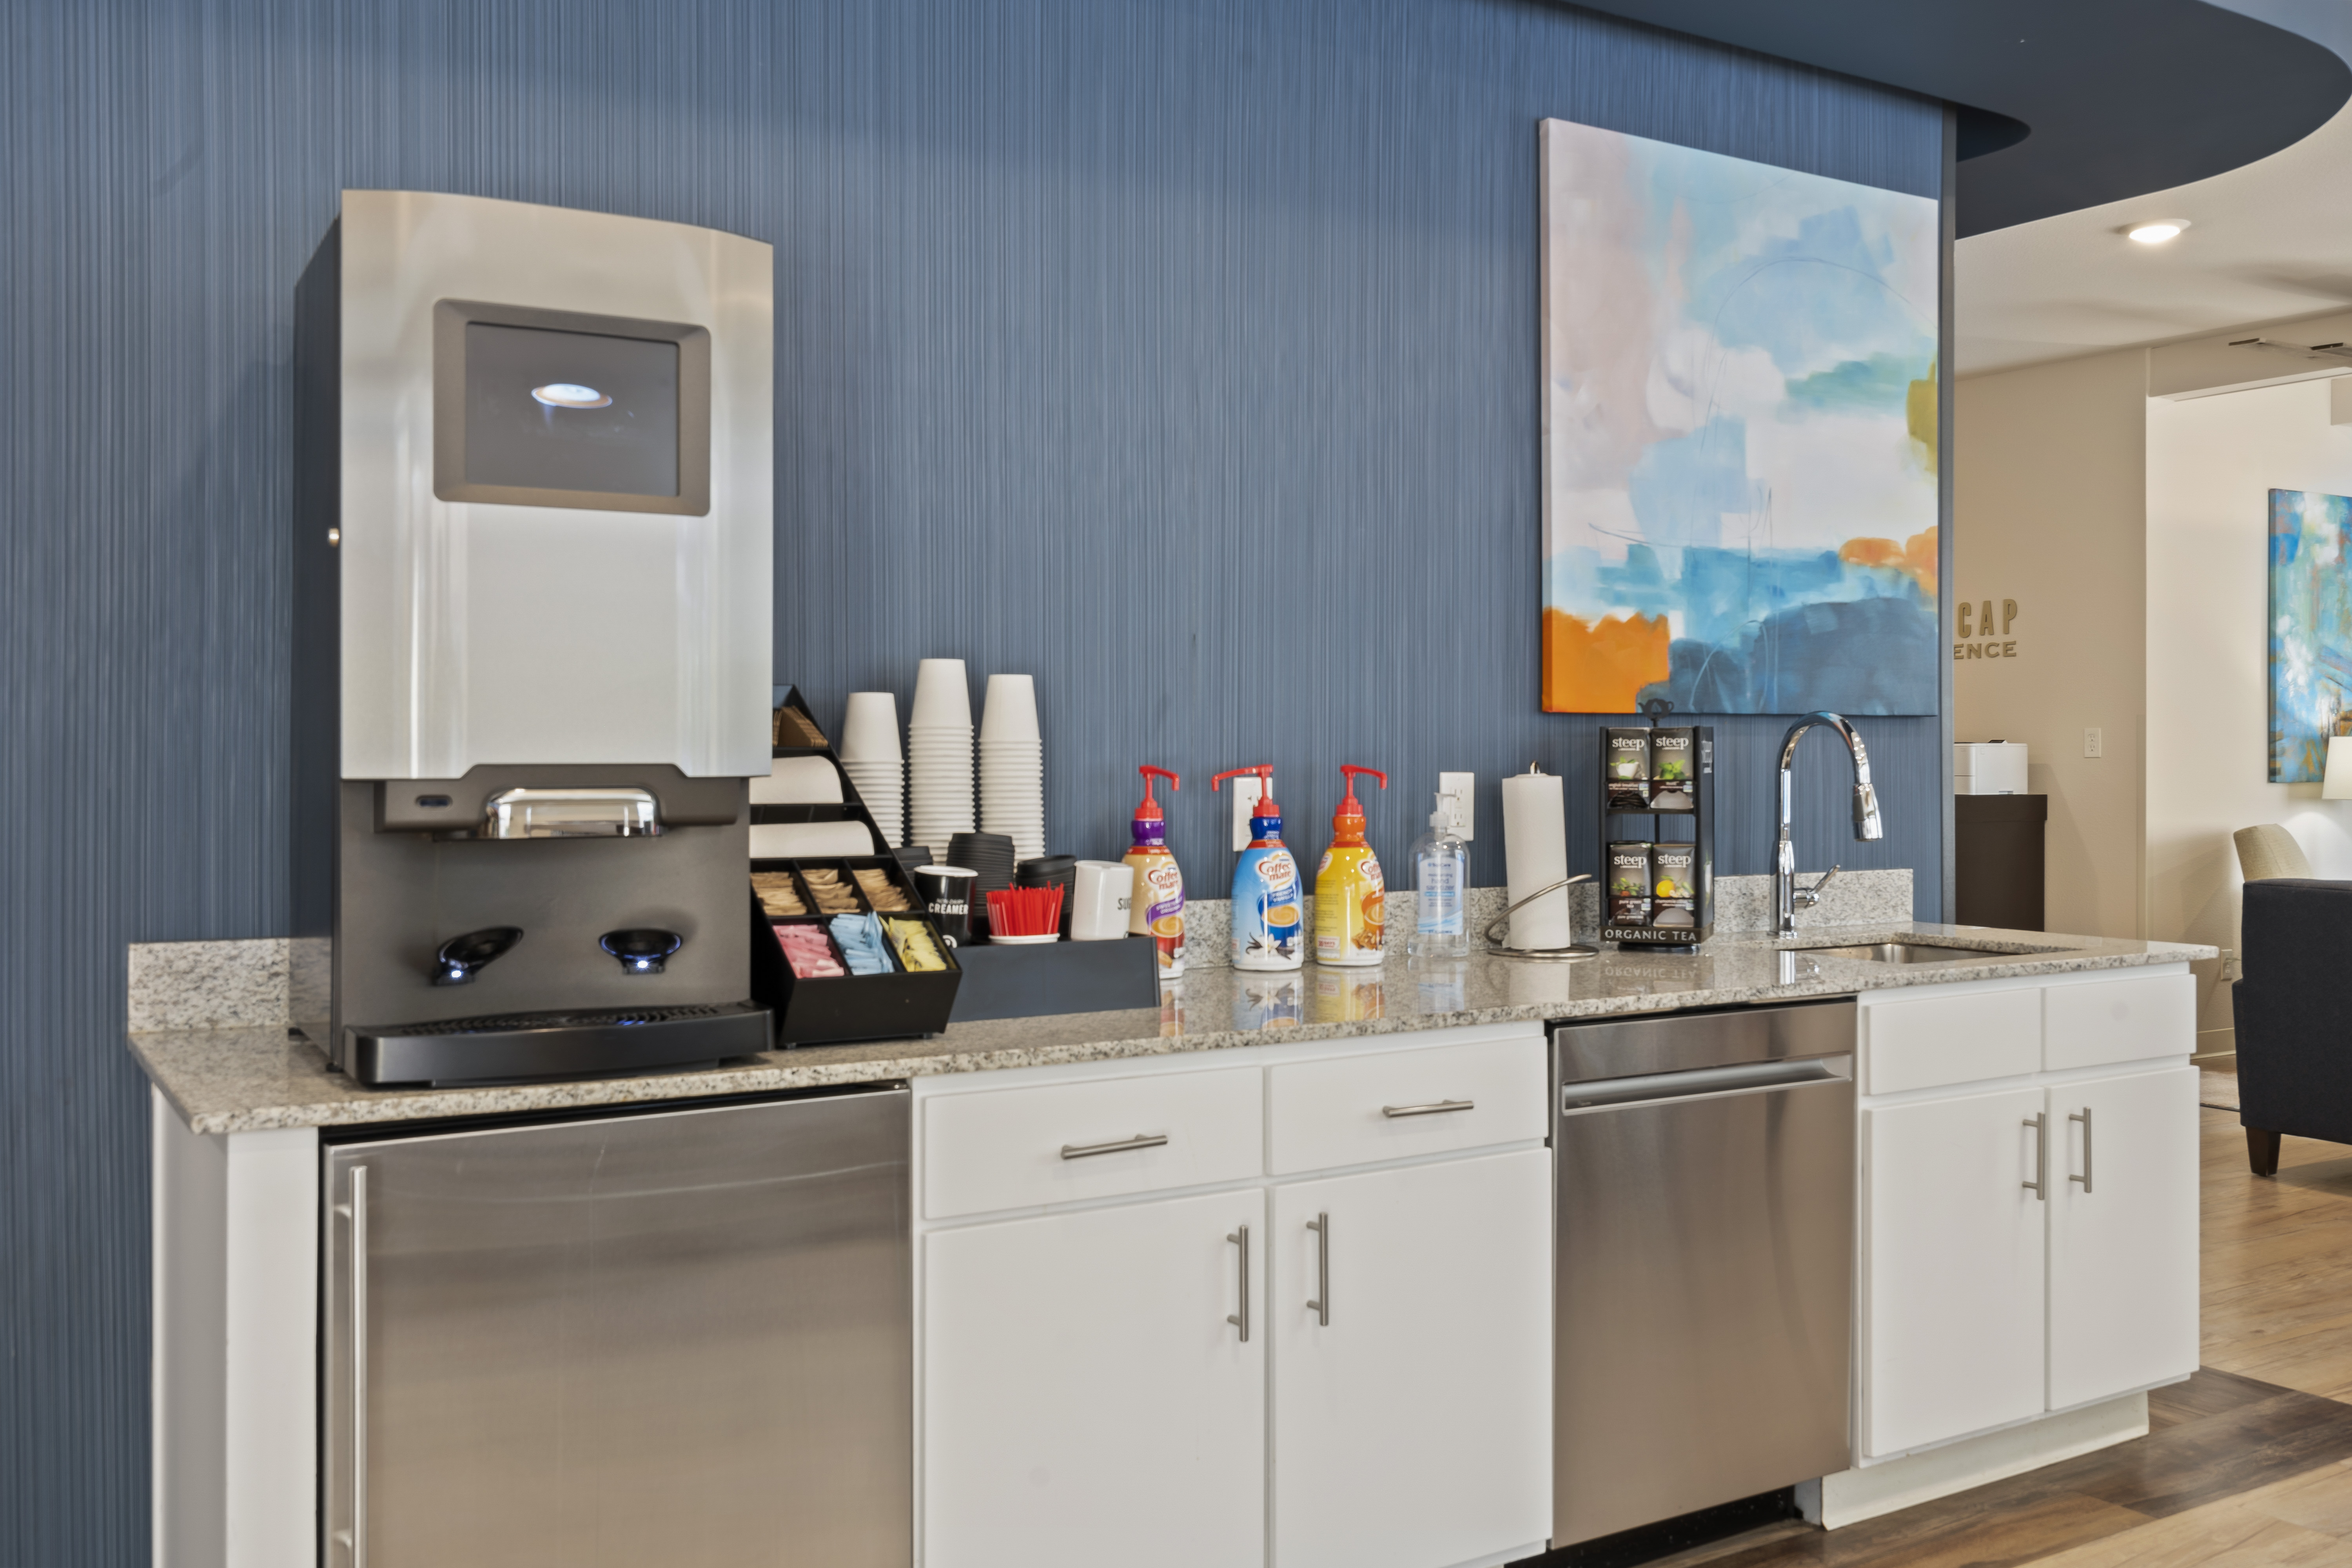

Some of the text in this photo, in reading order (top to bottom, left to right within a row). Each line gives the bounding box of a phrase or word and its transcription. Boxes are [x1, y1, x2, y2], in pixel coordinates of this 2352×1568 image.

[1958, 599, 2018, 638] CAP
[1954, 641, 2016, 660] ENCE
[1612, 737, 1644, 751] steep
[1656, 736, 1689, 750] steep
[1614, 854, 1646, 868] steep
[1658, 854, 1691, 867] steep
[1259, 861, 1291, 875] Coffee
[1148, 870, 1178, 884] Coffee
[1269, 871, 1291, 881] mate
[1159, 880, 1178, 890] mate
[929, 903, 969, 915] CREAMER
[1605, 929, 1697, 941] ORGANIC TEA
